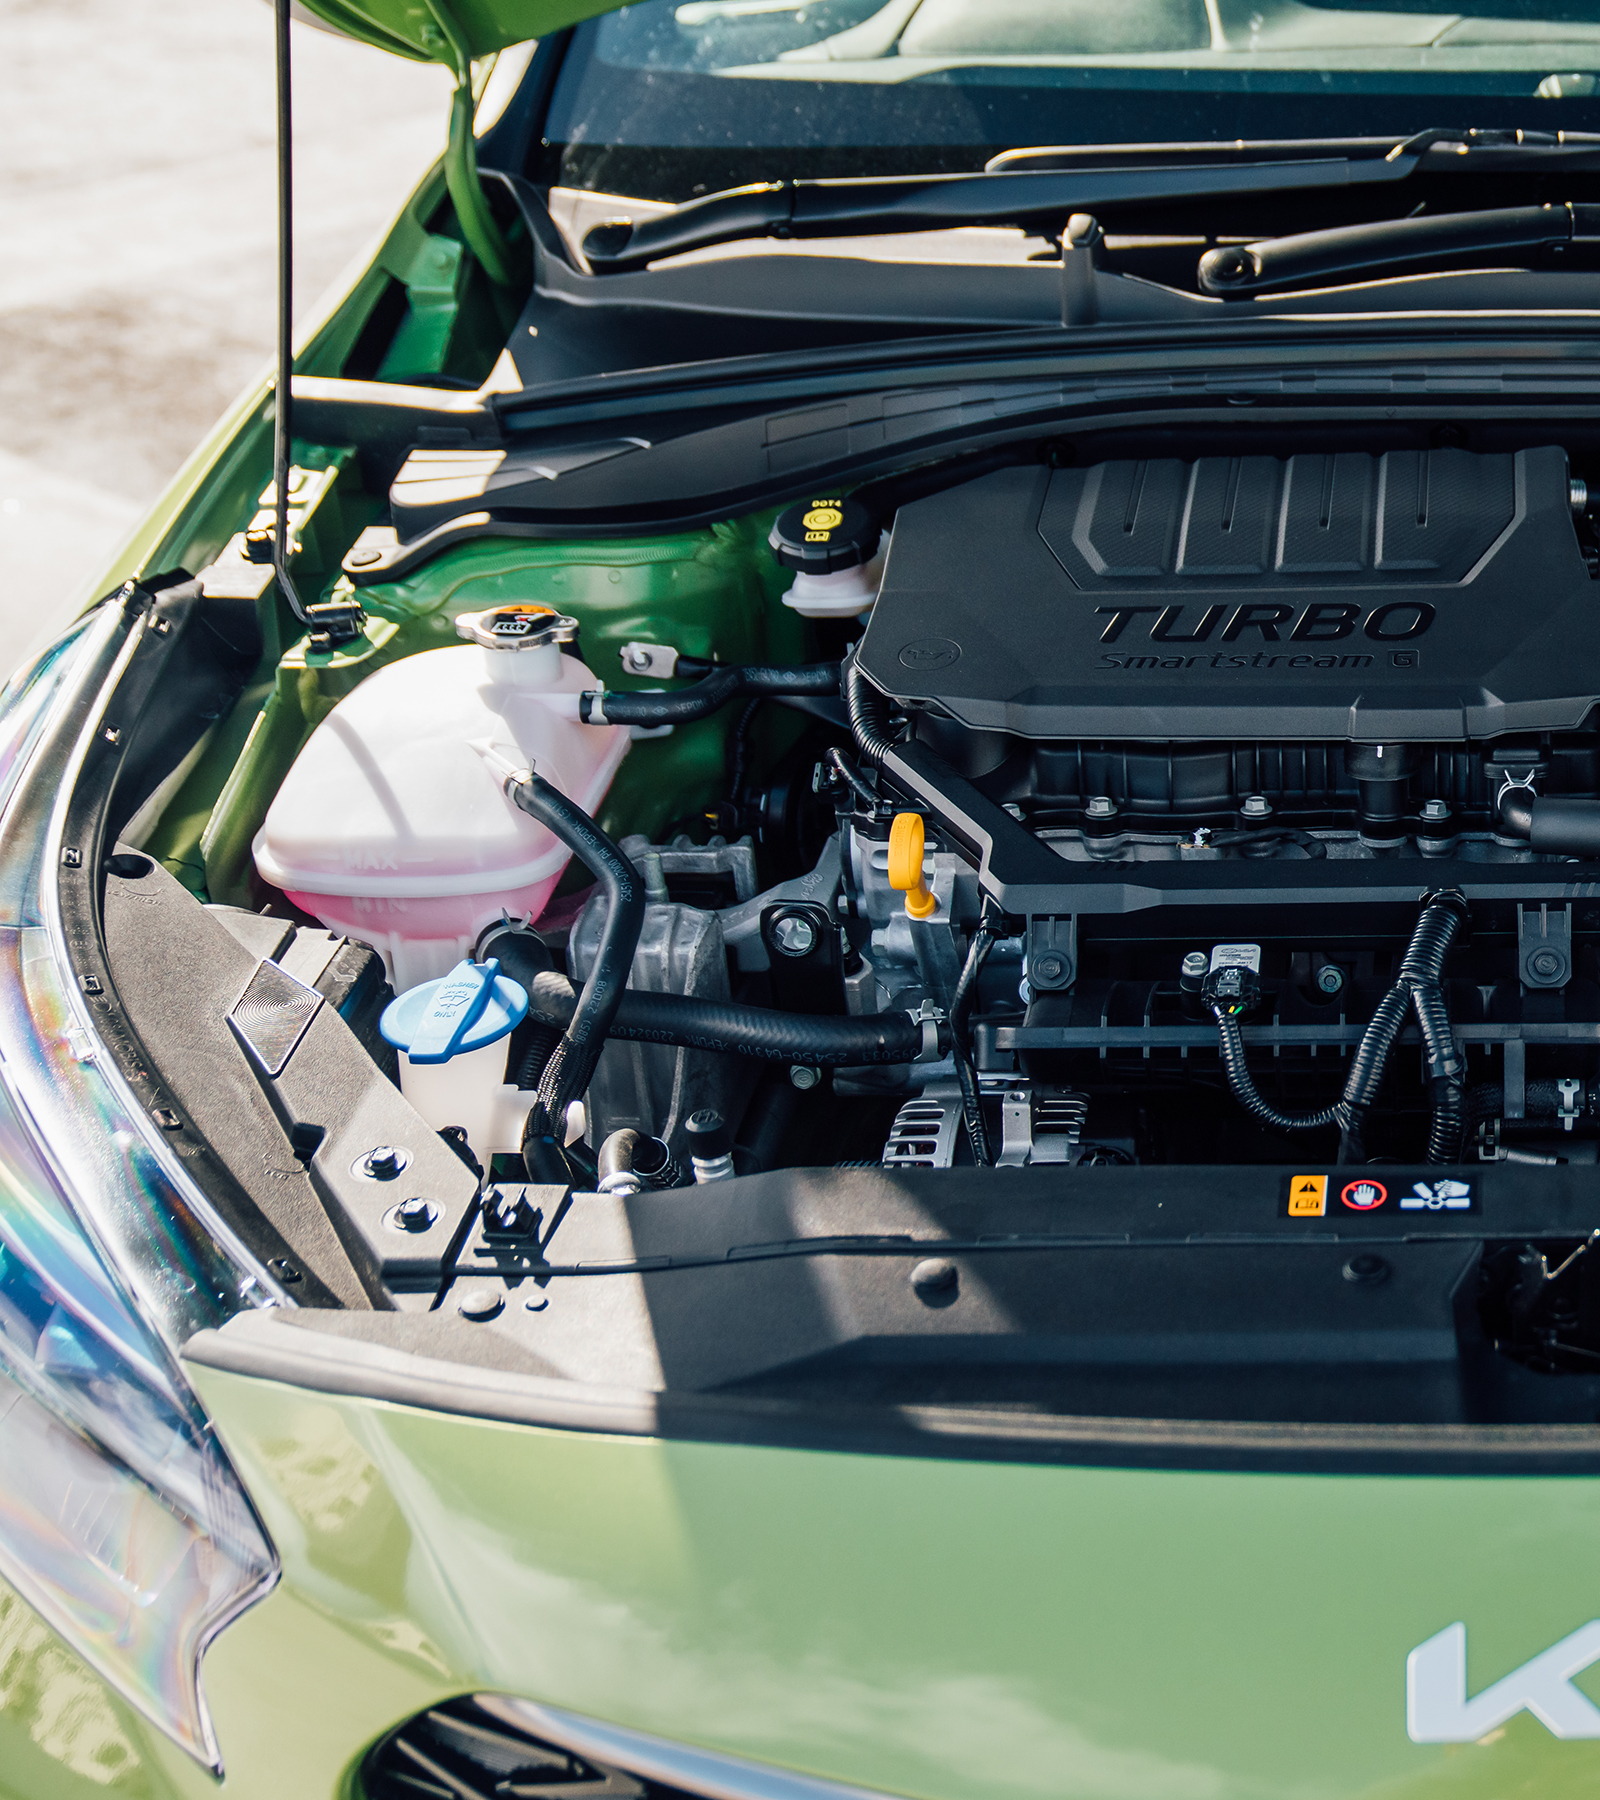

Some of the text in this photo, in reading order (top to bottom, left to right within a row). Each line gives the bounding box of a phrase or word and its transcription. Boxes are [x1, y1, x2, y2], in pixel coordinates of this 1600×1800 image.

[811, 500, 842, 508] DOT4
[1094, 601, 1437, 643] TURBO
[1094, 651, 1375, 669] Smartstream
[894, 825, 906, 858] ENGINE
[343, 850, 398, 870] MAX
[351, 897, 407, 913] MIN
[443, 981, 480, 990] WASHER
[433, 1010, 457, 1018] ONLY
[684, 1034, 729, 1050] >EPDM<
